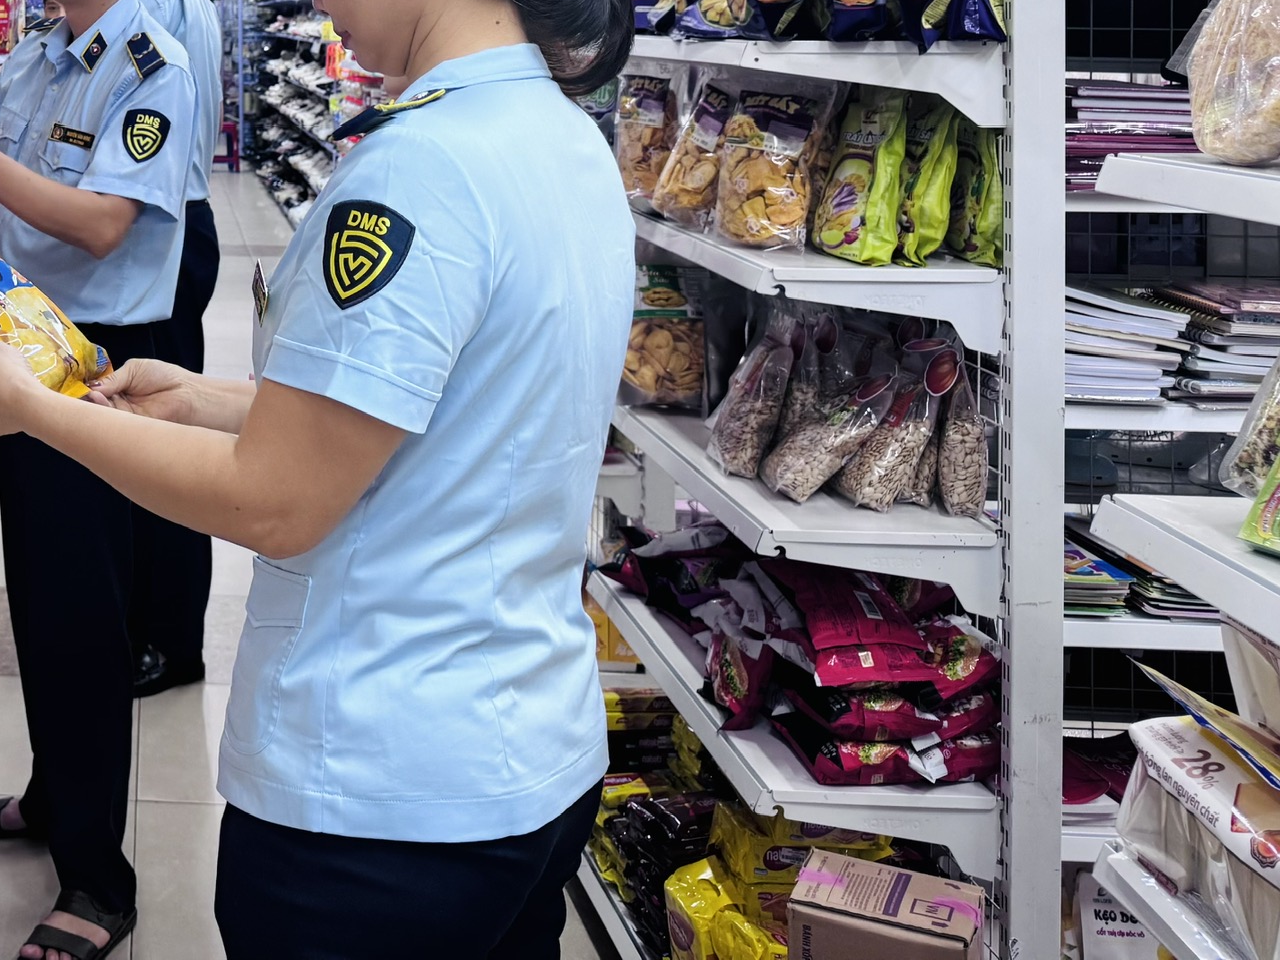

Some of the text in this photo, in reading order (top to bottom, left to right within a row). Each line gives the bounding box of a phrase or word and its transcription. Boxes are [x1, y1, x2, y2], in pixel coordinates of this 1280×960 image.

[136, 114, 161, 129] DMS
[347, 210, 391, 235] DMS
[1171, 748, 1226, 790] 28%
[1161, 767, 1174, 788] lan
[1173, 780, 1201, 810] nguyên
[1200, 805, 1220, 828] chất
